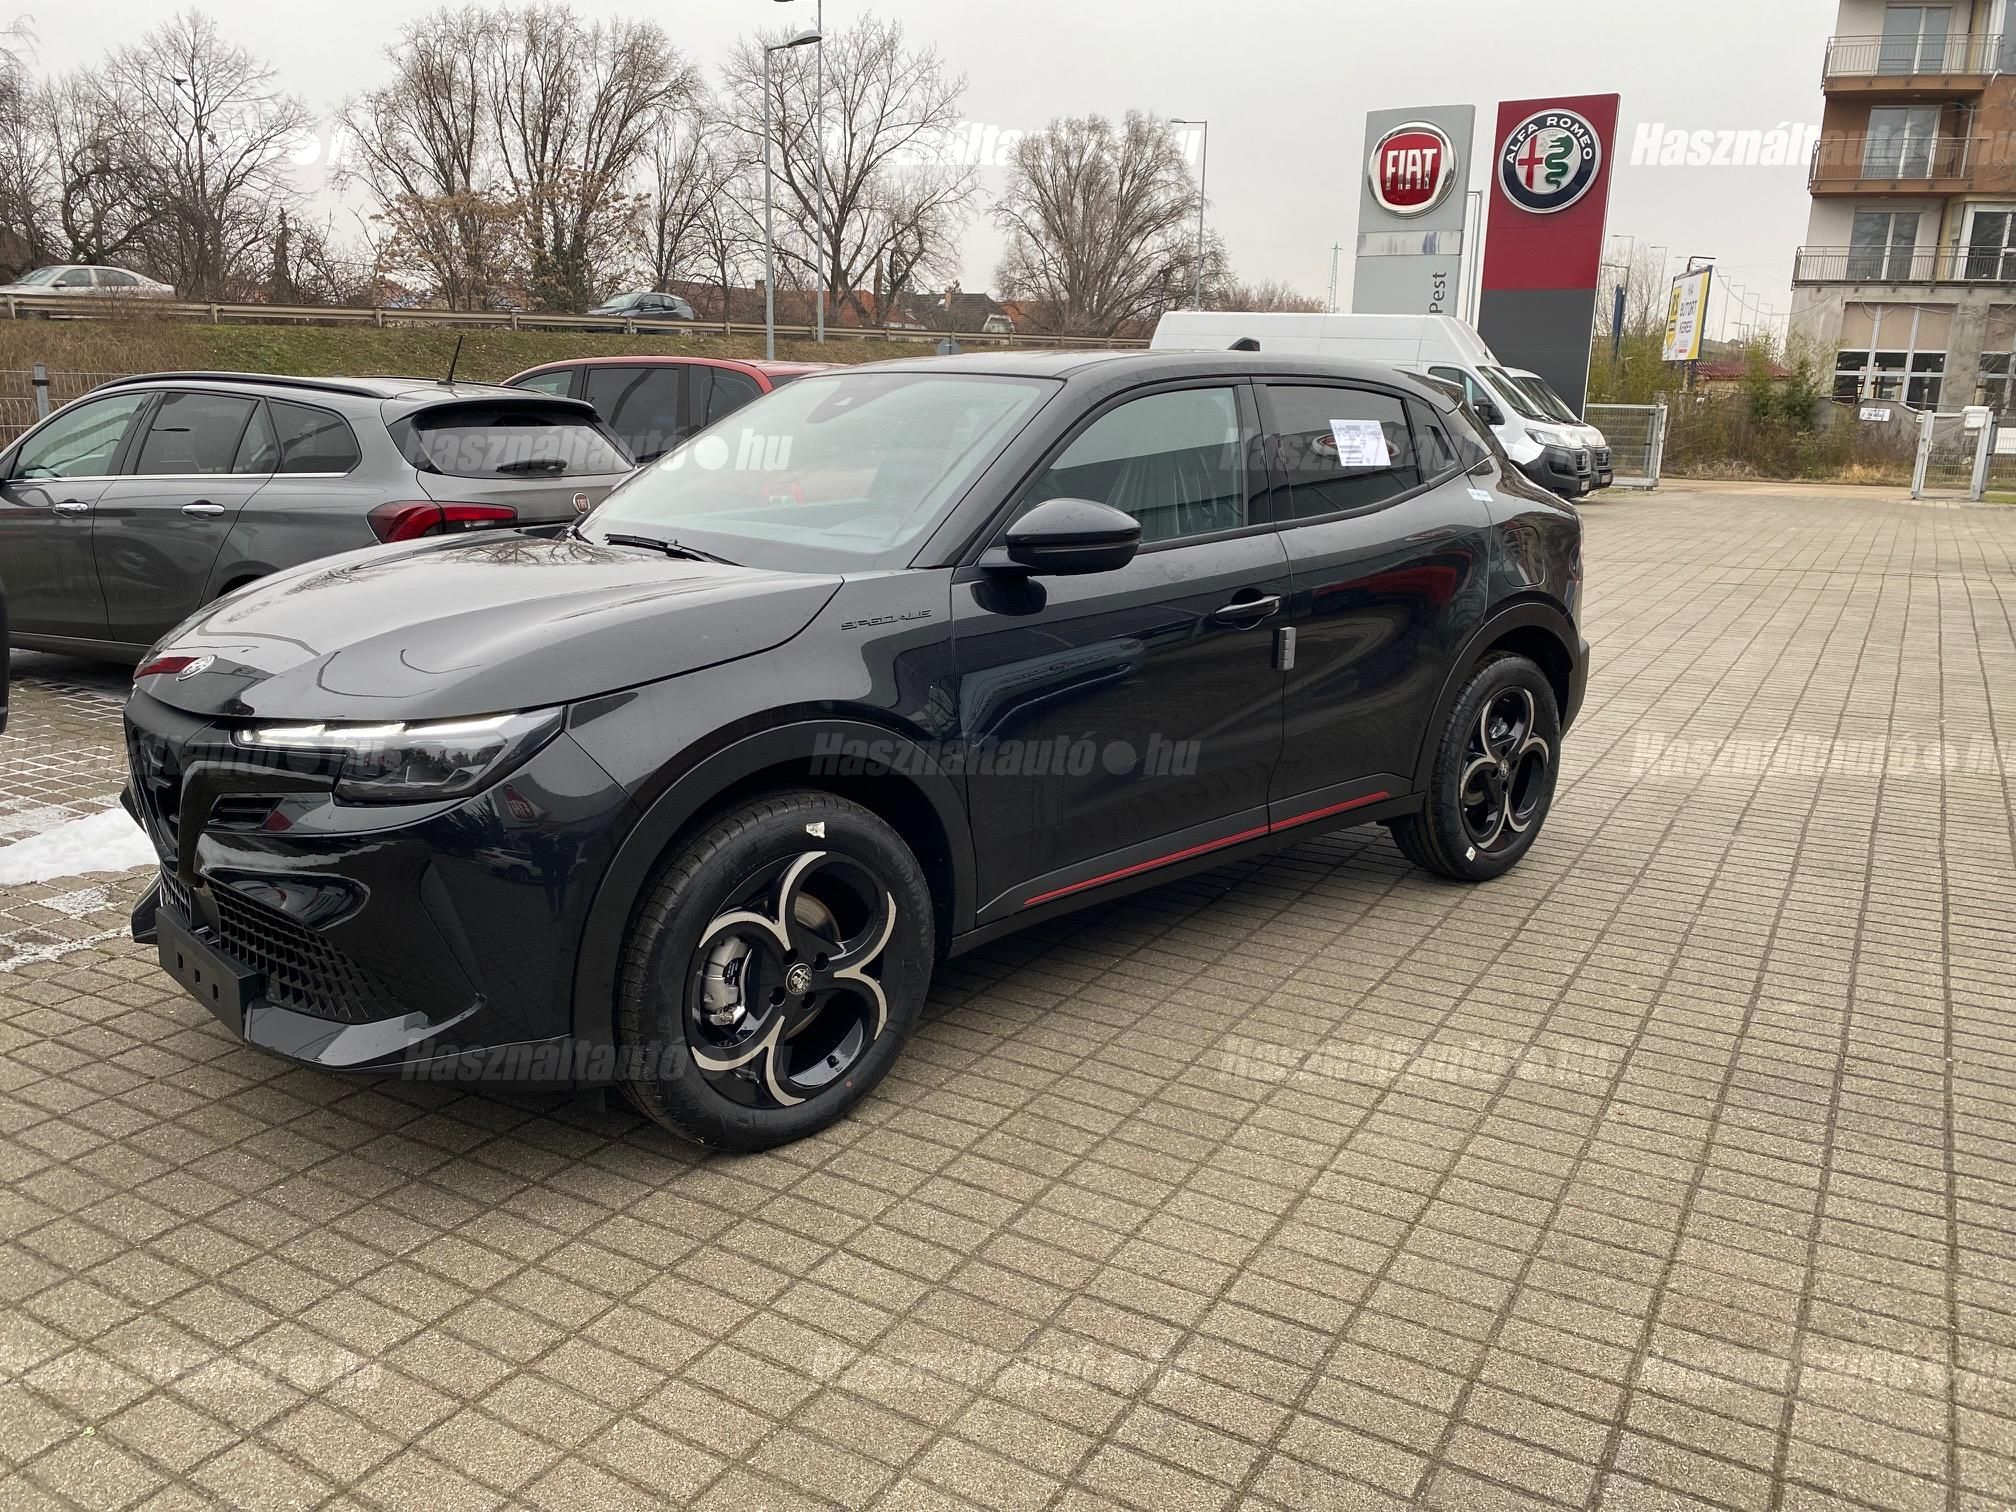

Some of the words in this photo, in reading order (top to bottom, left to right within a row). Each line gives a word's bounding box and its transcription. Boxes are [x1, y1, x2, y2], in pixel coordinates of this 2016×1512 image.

[1506, 122, 1539, 164] ALFA
[1546, 116, 1594, 161] ROMEO
[1386, 148, 1438, 190] FIAT
[1429, 271, 1447, 314] Pest
